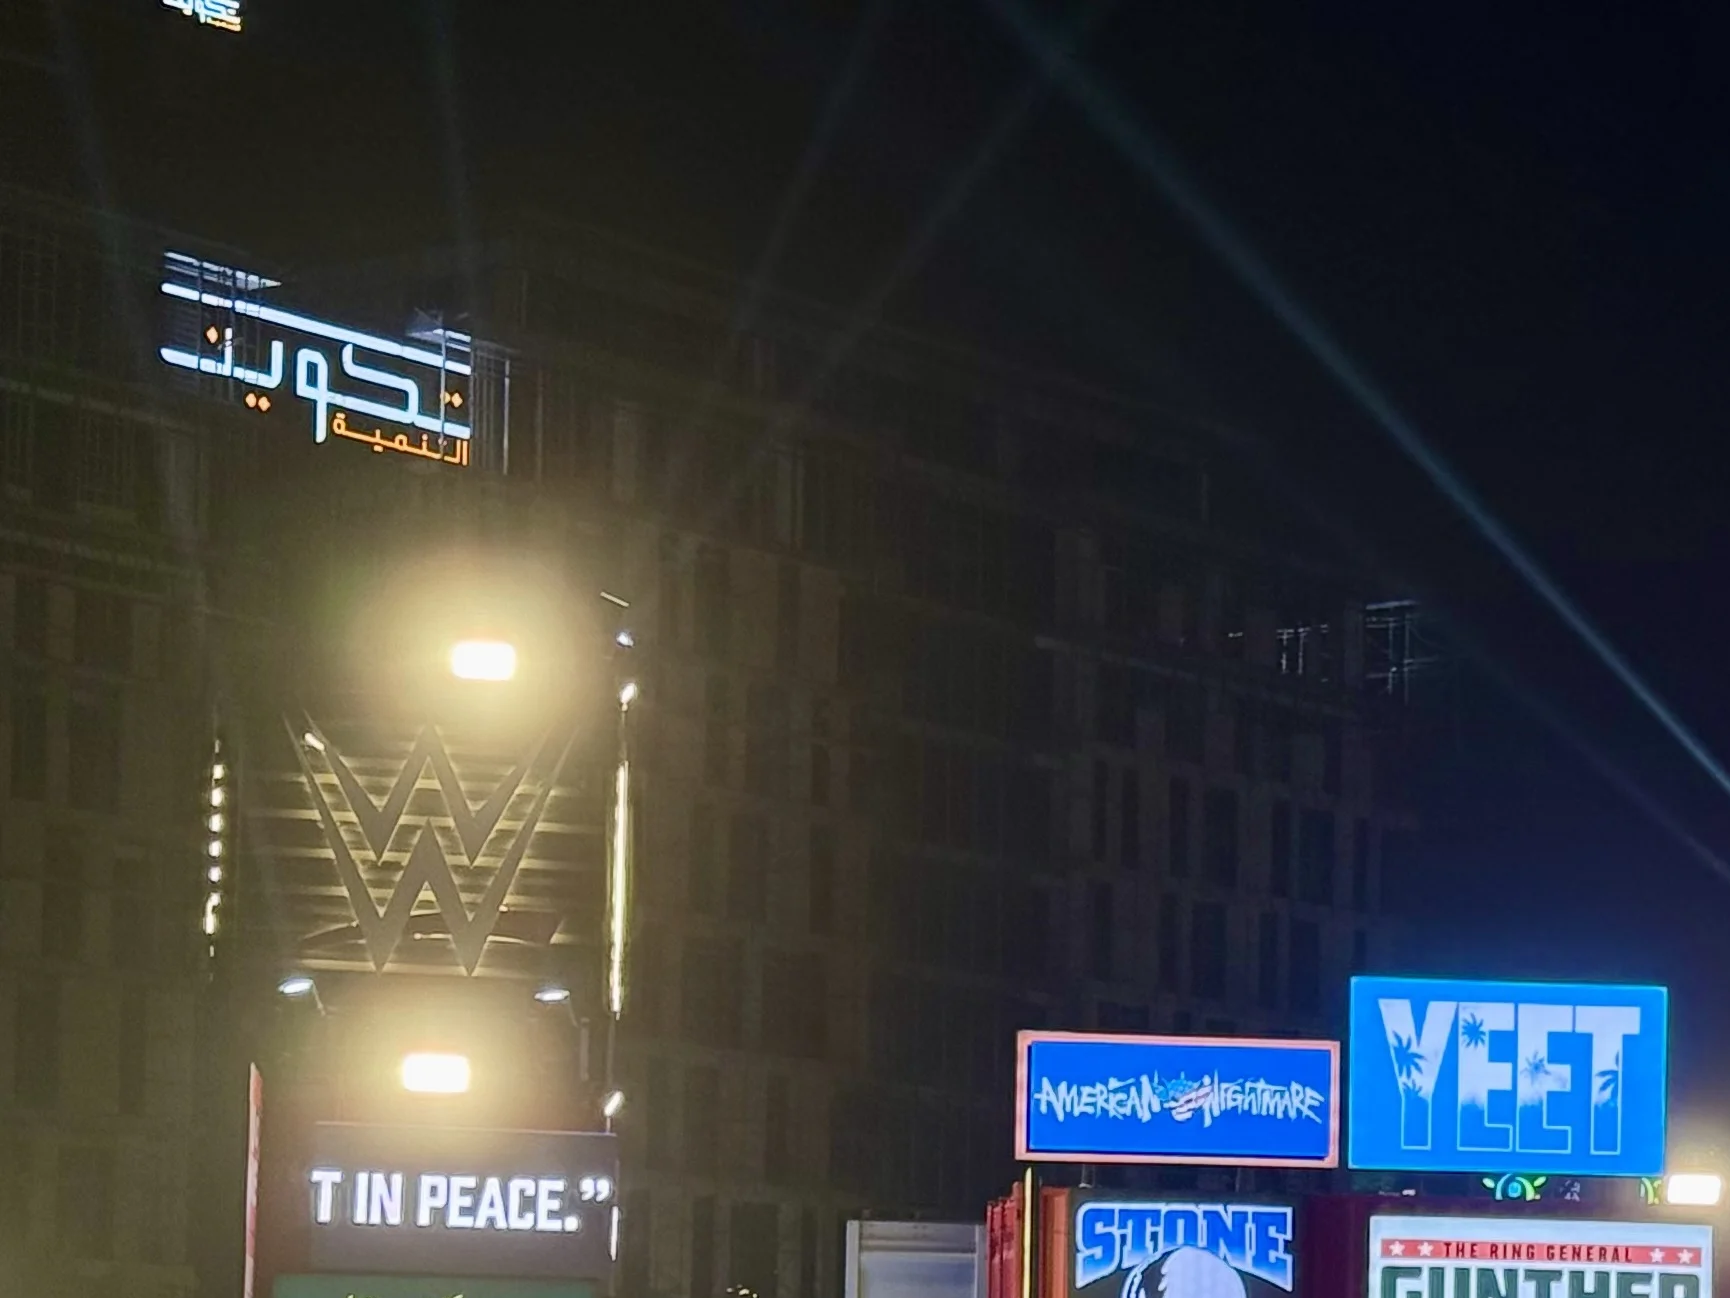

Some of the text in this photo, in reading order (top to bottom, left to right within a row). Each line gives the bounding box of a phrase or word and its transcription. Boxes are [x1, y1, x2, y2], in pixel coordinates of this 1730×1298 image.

[1378, 998, 1641, 1155] YEET
[311, 1169, 342, 1225] T
[352, 1170, 404, 1226] IN
[1075, 1201, 1294, 1292] STONE
[1443, 1242, 1633, 1263] THE RING GENERAL
